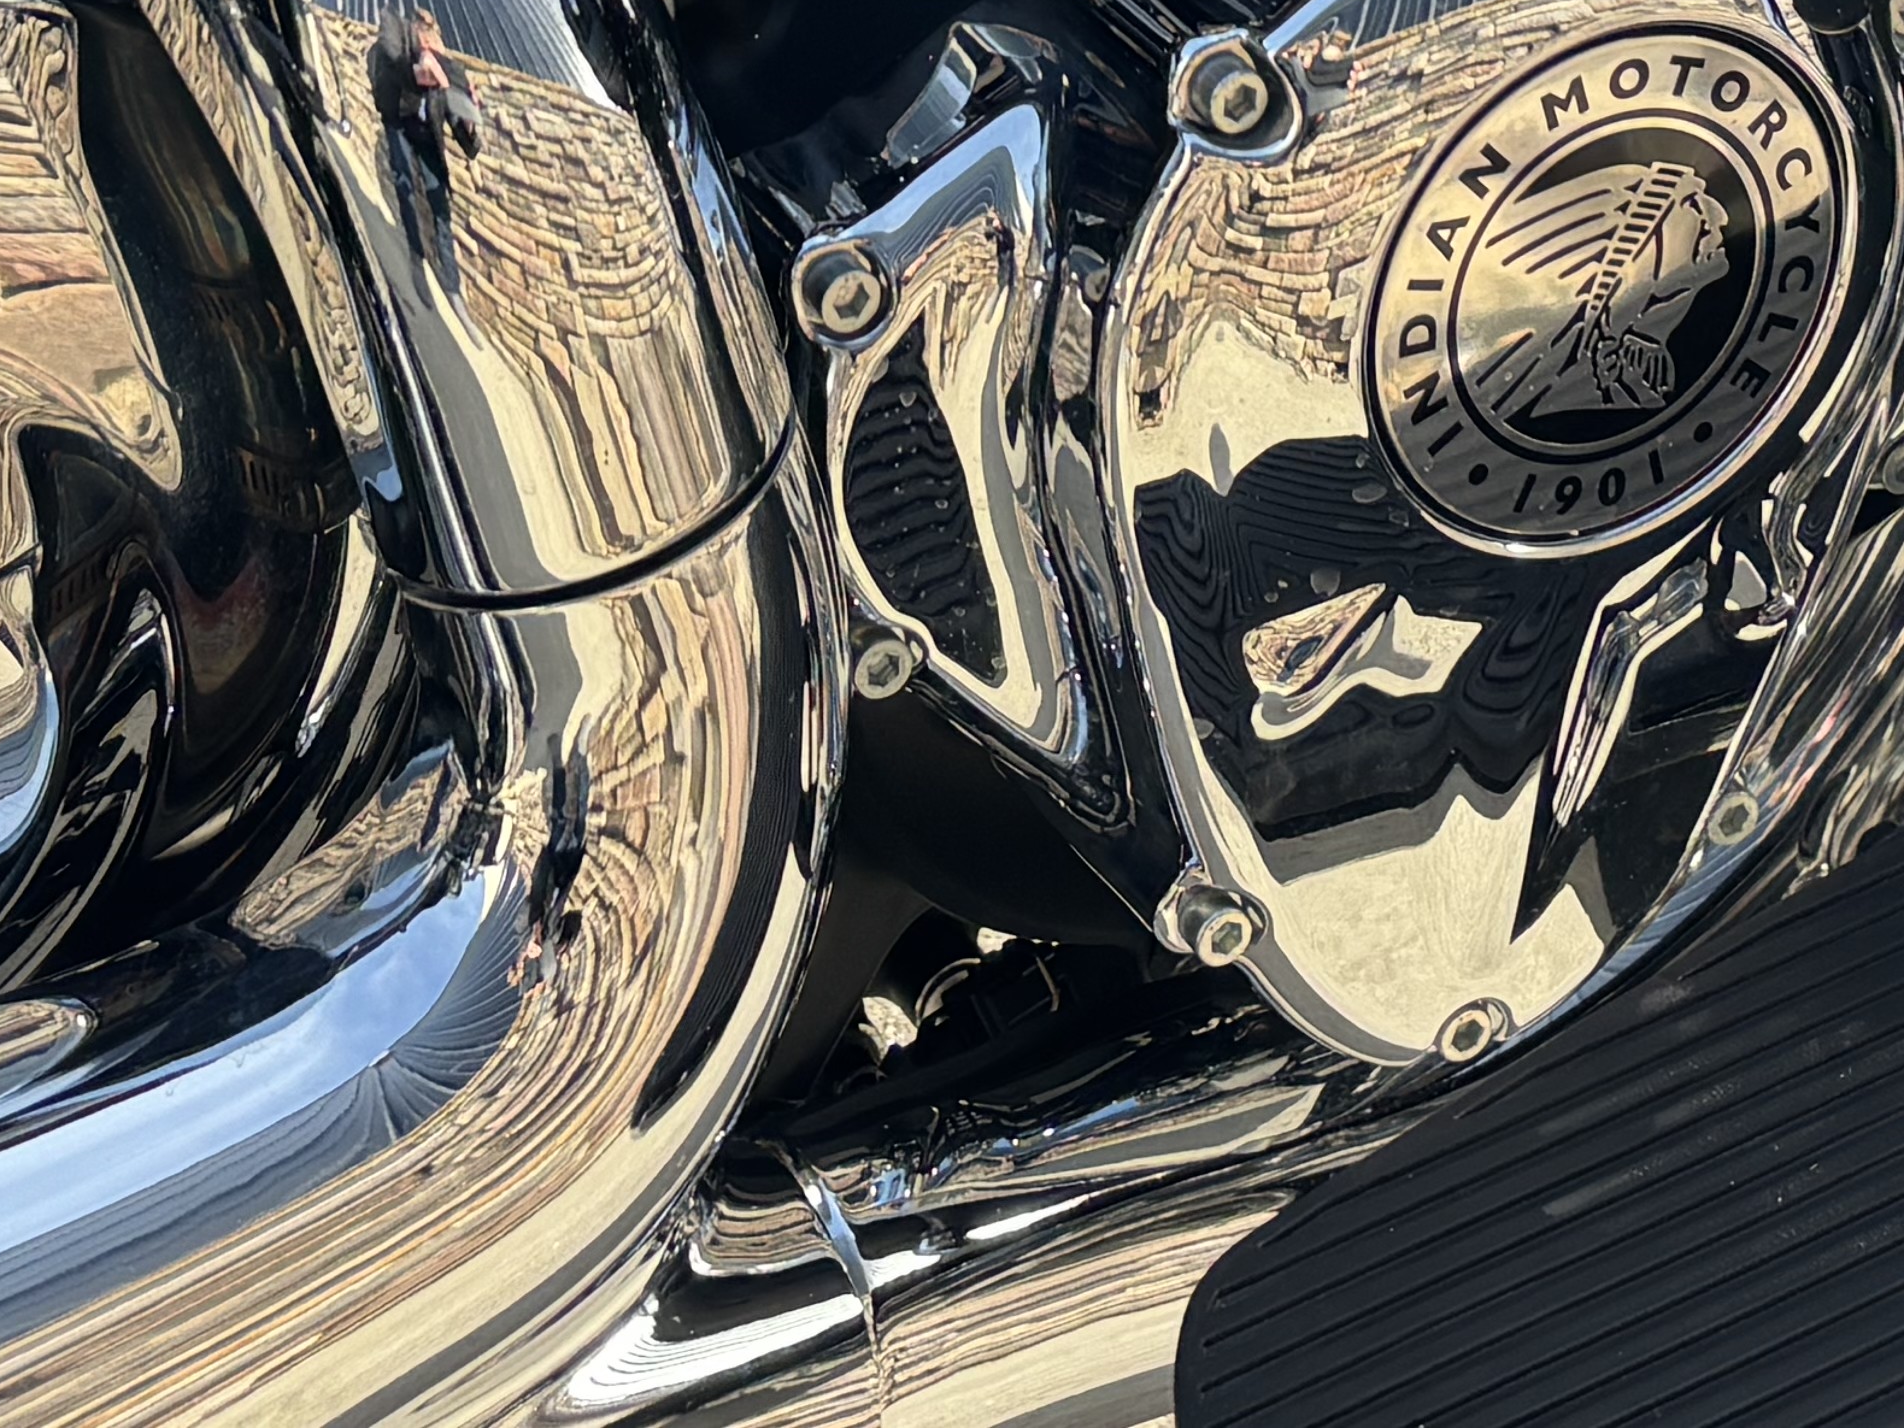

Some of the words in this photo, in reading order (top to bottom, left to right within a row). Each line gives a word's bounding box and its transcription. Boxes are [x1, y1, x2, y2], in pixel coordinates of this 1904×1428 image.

[1398, 142, 1513, 456] INDIAN
[1540, 54, 1821, 400] MOTORCYCLE
[1513, 448, 1664, 514] 1901
